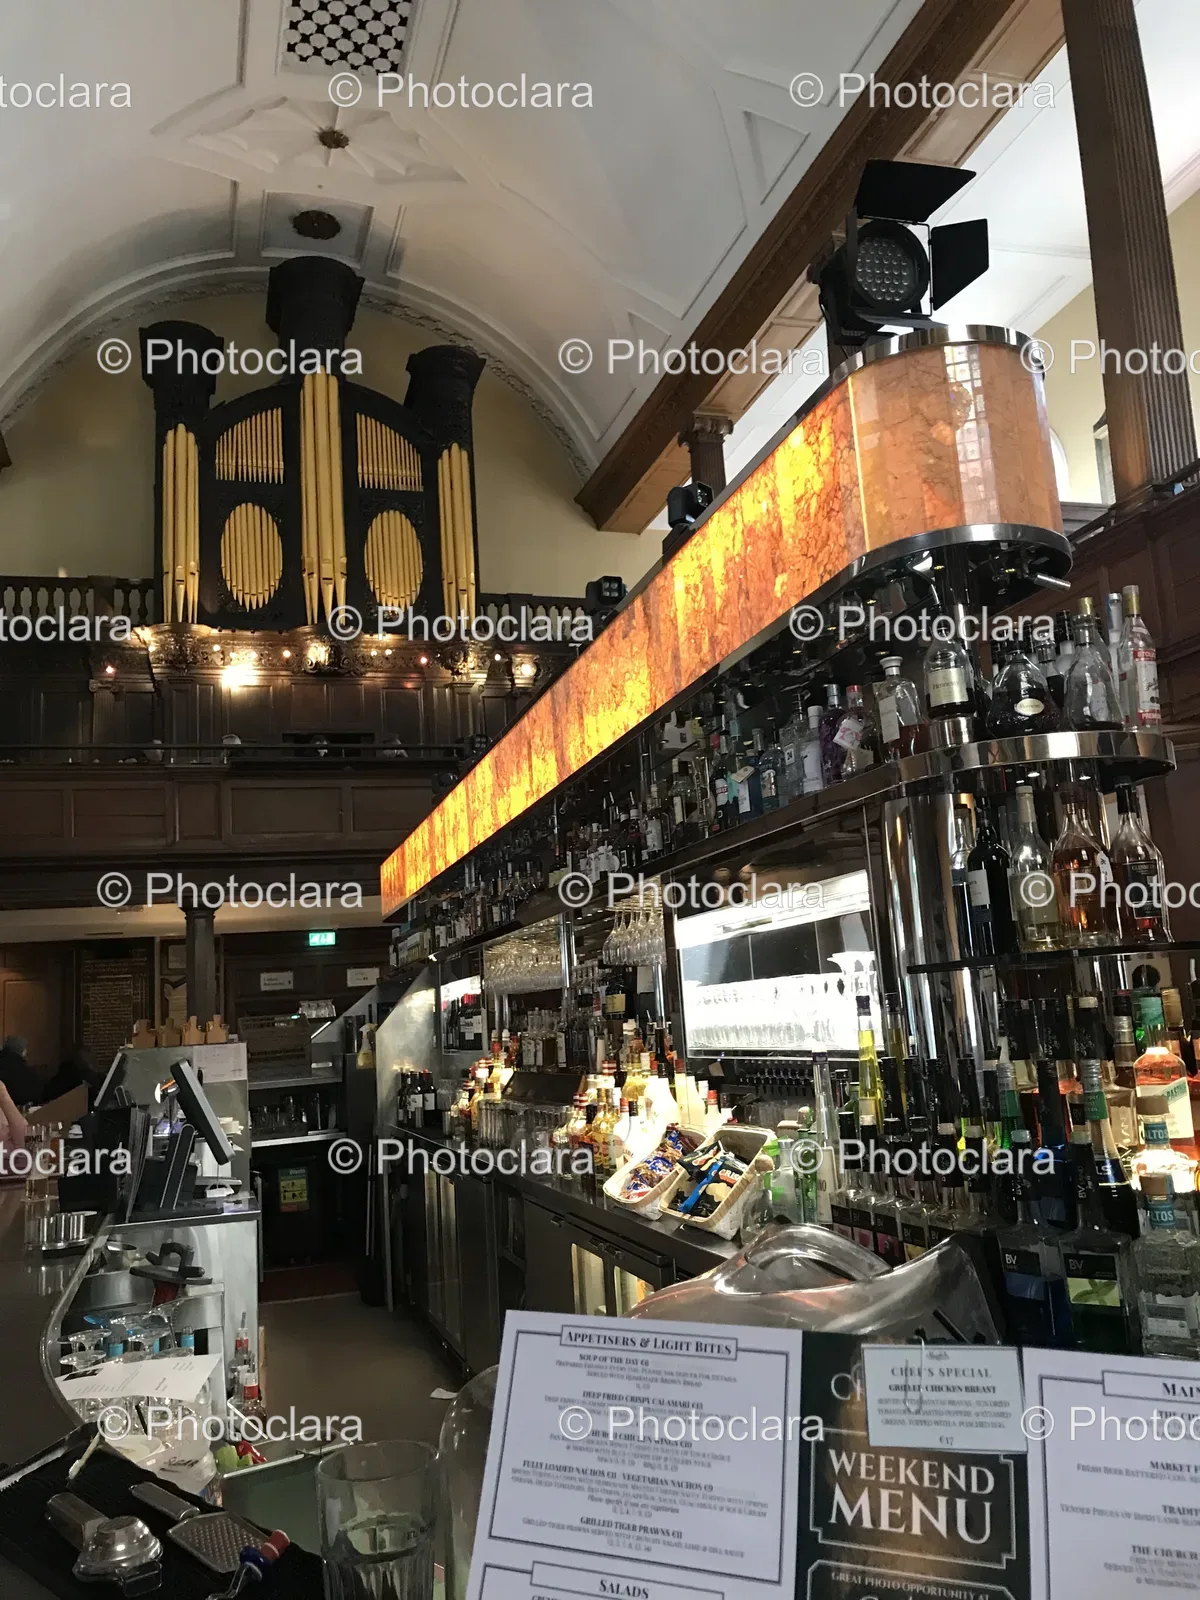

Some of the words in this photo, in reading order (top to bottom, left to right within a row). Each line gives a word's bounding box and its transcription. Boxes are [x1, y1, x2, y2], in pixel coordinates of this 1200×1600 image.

[1005, 1254, 1017, 1265] BV
[1069, 1259, 1084, 1271] BV
[565, 1331, 636, 1348] APPETISERS
[639, 1337, 650, 1349] &
[653, 1336, 692, 1353] LIGHT
[695, 1341, 732, 1356] BITES
[578, 1353, 597, 1361] SOUP
[938, 1367, 992, 1378] SPECIAL
[925, 1384, 963, 1393] CHICKEN
[965, 1385, 997, 1394] BREAST
[582, 1390, 601, 1398] DEEP
[602, 1392, 624, 1401] FRIED
[624, 1394, 650, 1403] CRISPY
[651, 1397, 690, 1408] CALAMARI
[939, 1435, 953, 1446] €17
[522, 1459, 543, 1469] FULLY
[544, 1462, 574, 1473] LOADED
[575, 1466, 606, 1477] NACHOS
[828, 1449, 995, 1494] WEEKEND
[1150, 1461, 1192, 1473] MARKET
[621, 1473, 669, 1486] VEGETARIAN
[670, 1479, 702, 1490] NACHOS
[828, 1482, 992, 1544] MENU
[579, 1516, 613, 1528] GRILLED
[613, 1521, 637, 1532] TIGER
[638, 1524, 670, 1536] PRAWNS
[1131, 1545, 1150, 1556] THE
[1154, 1549, 1198, 1560] CHURCH
[600, 1579, 649, 1599] SALADS
[831, 1572, 862, 1584] GREAT
[865, 1577, 900, 1591] PHOTO
[902, 1582, 976, 1600] OPPORTUNITY
